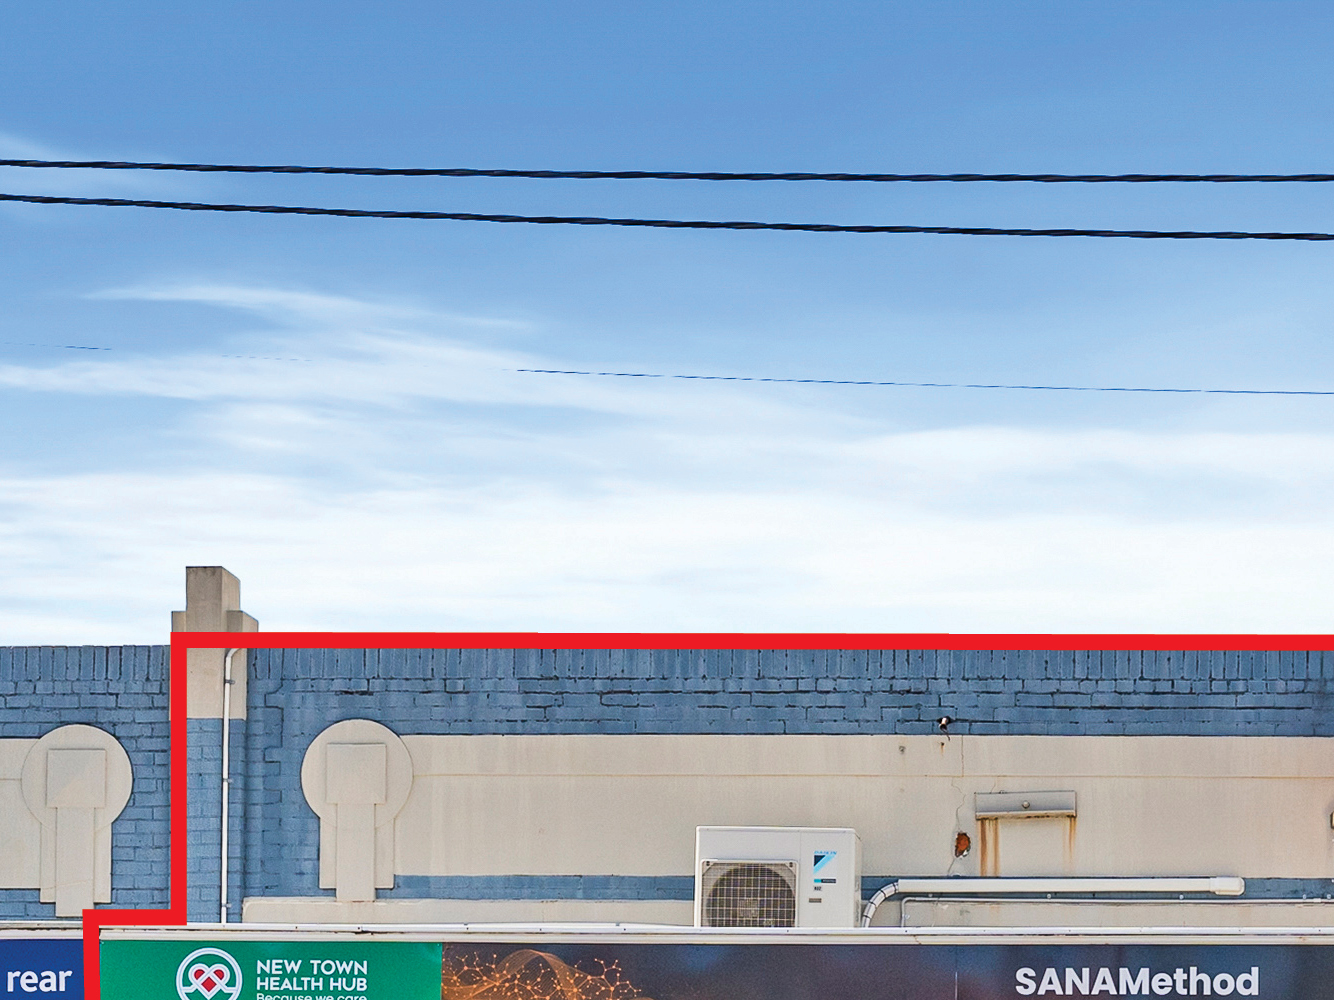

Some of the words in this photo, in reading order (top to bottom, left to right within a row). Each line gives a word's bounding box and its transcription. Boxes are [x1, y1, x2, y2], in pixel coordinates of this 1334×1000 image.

[257, 960, 302, 974] NEW
[310, 960, 367, 975] TOWN
[7, 970, 72, 992] rear
[257, 977, 323, 990] HEALTH
[330, 978, 367, 991] HUB
[1015, 967, 1259, 996] SANAMethod
